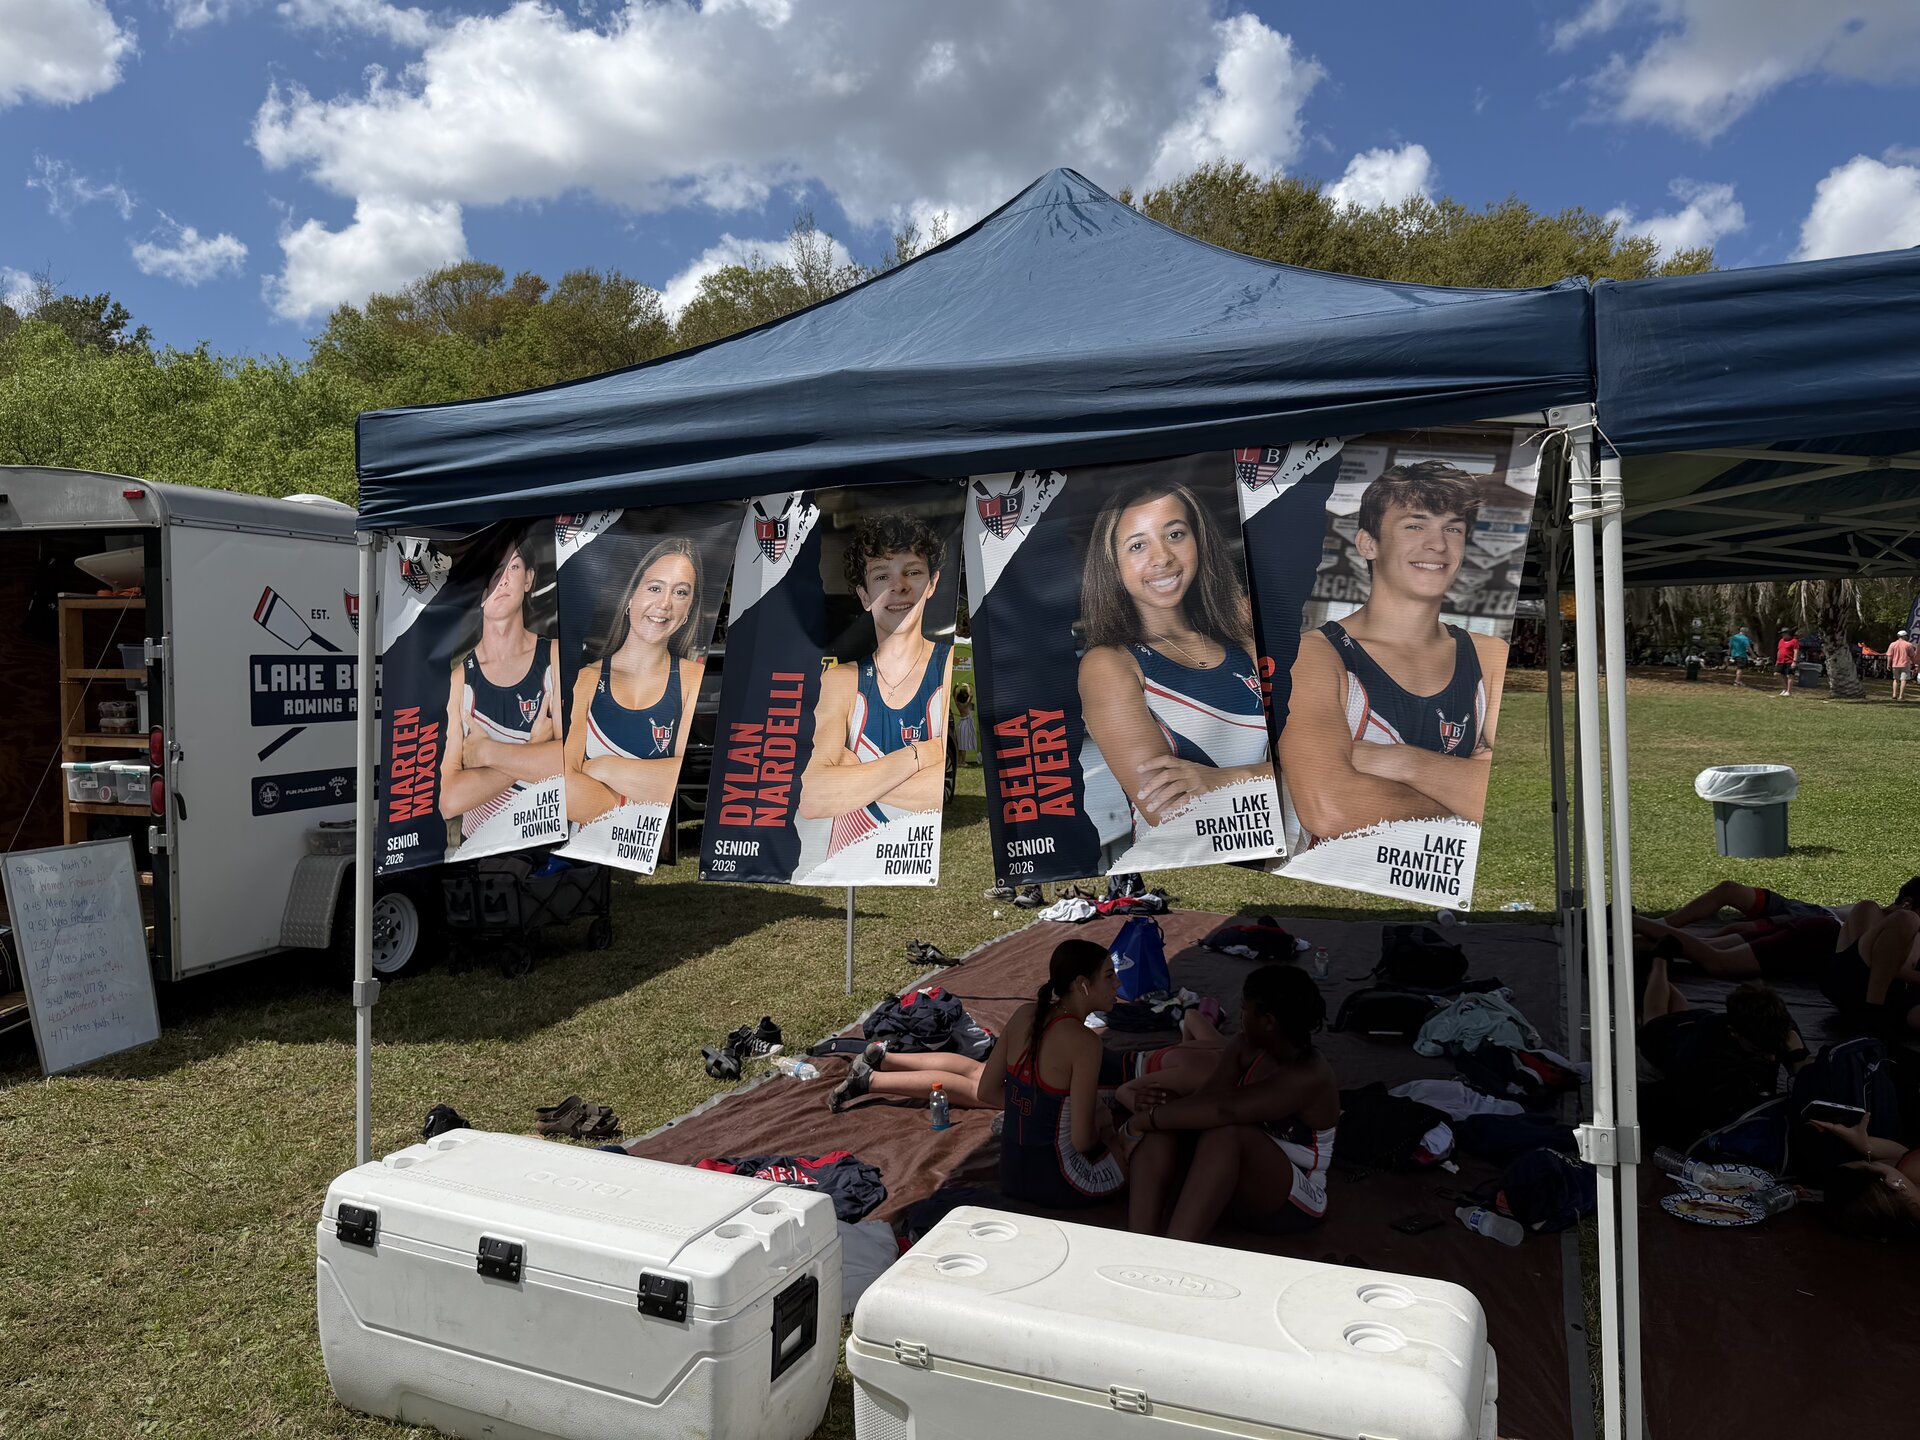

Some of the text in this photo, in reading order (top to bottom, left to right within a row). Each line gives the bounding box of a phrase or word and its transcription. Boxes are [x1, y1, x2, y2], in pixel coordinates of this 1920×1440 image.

[311, 608, 331, 620] EST.
[254, 664, 324, 692] LAKE
[284, 697, 343, 715] ROWING
[753, 672, 806, 827] NARDELLI
[389, 706, 420, 823] MARTEN
[411, 721, 440, 821] MIXON
[993, 713, 1039, 825] BELLA
[1028, 707, 1076, 818] AVERY
[719, 722, 765, 826] DYLAN
[536, 789, 560, 806] LAKE
[1232, 793, 1269, 815] LAKE
[513, 803, 560, 827] BRANTLEY
[637, 815, 663, 832] LAKE
[1195, 811, 1271, 836] BRANTLEY
[521, 819, 561, 839] ROWING
[611, 826, 658, 847] BRANTLEY
[908, 825, 934, 842] LAKE
[387, 832, 419, 851] SENIOR
[714, 839, 759, 858] SENIOR
[875, 840, 933, 859] BRANTLEY
[1006, 836, 1056, 858] SENIOR
[1212, 828, 1275, 852] ROWING
[1423, 833, 1467, 858] LAKE
[385, 853, 404, 866] 2026
[616, 842, 654, 863] ROWING
[1376, 845, 1465, 877] BRANTLEY
[712, 859, 736, 873] 2026
[884, 857, 932, 875] ROWING
[1008, 860, 1034, 876] 2026
[1389, 866, 1460, 896] ROWING
